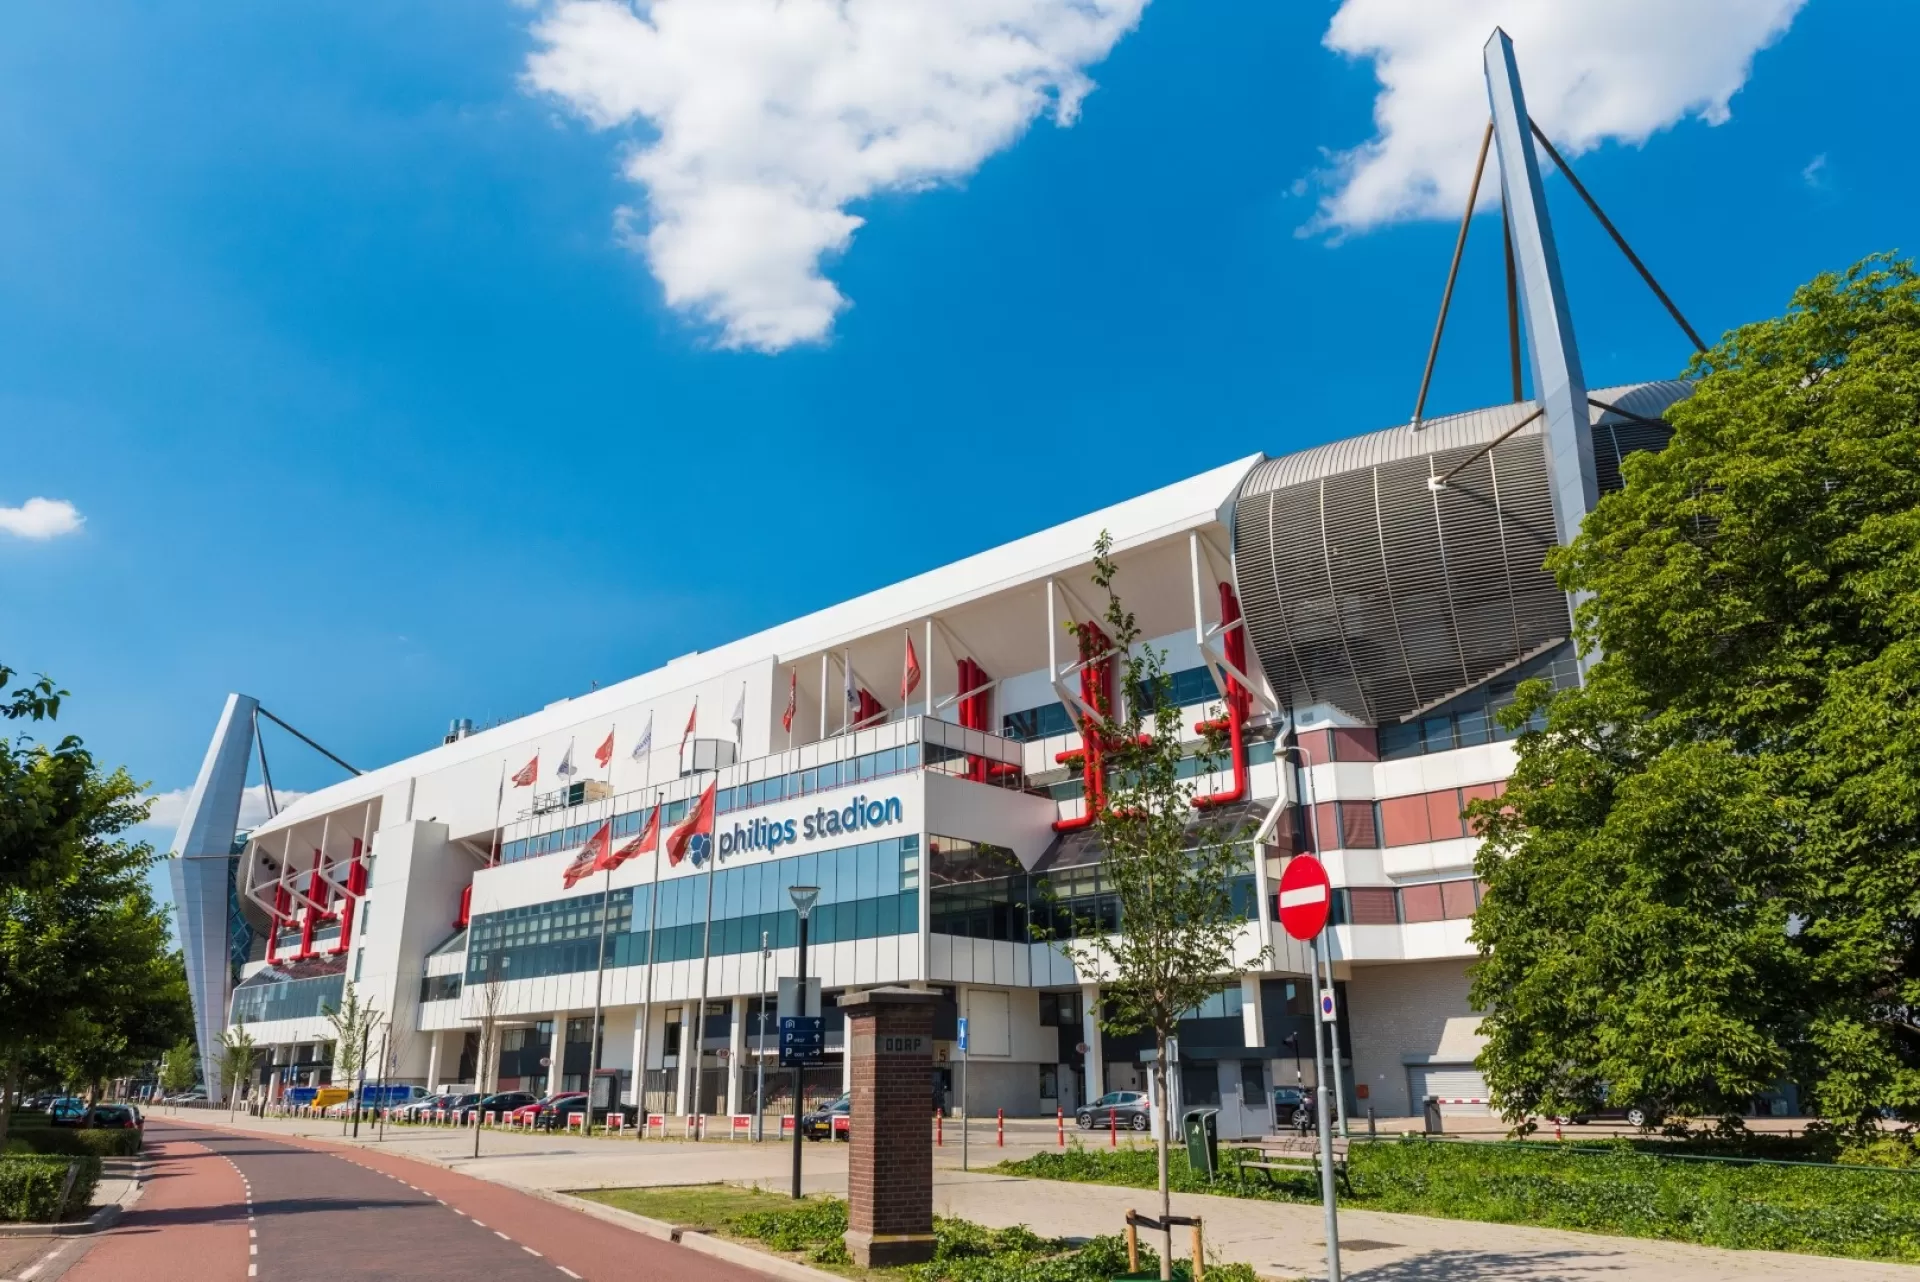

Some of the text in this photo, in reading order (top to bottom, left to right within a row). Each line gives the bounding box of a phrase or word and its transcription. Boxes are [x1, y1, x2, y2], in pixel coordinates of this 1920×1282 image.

[719, 794, 902, 861] philips stadion
[786, 1033, 793, 1043] P
[885, 1038, 921, 1052] DORP
[785, 1047, 793, 1058] P
[939, 1049, 947, 1063] 5
